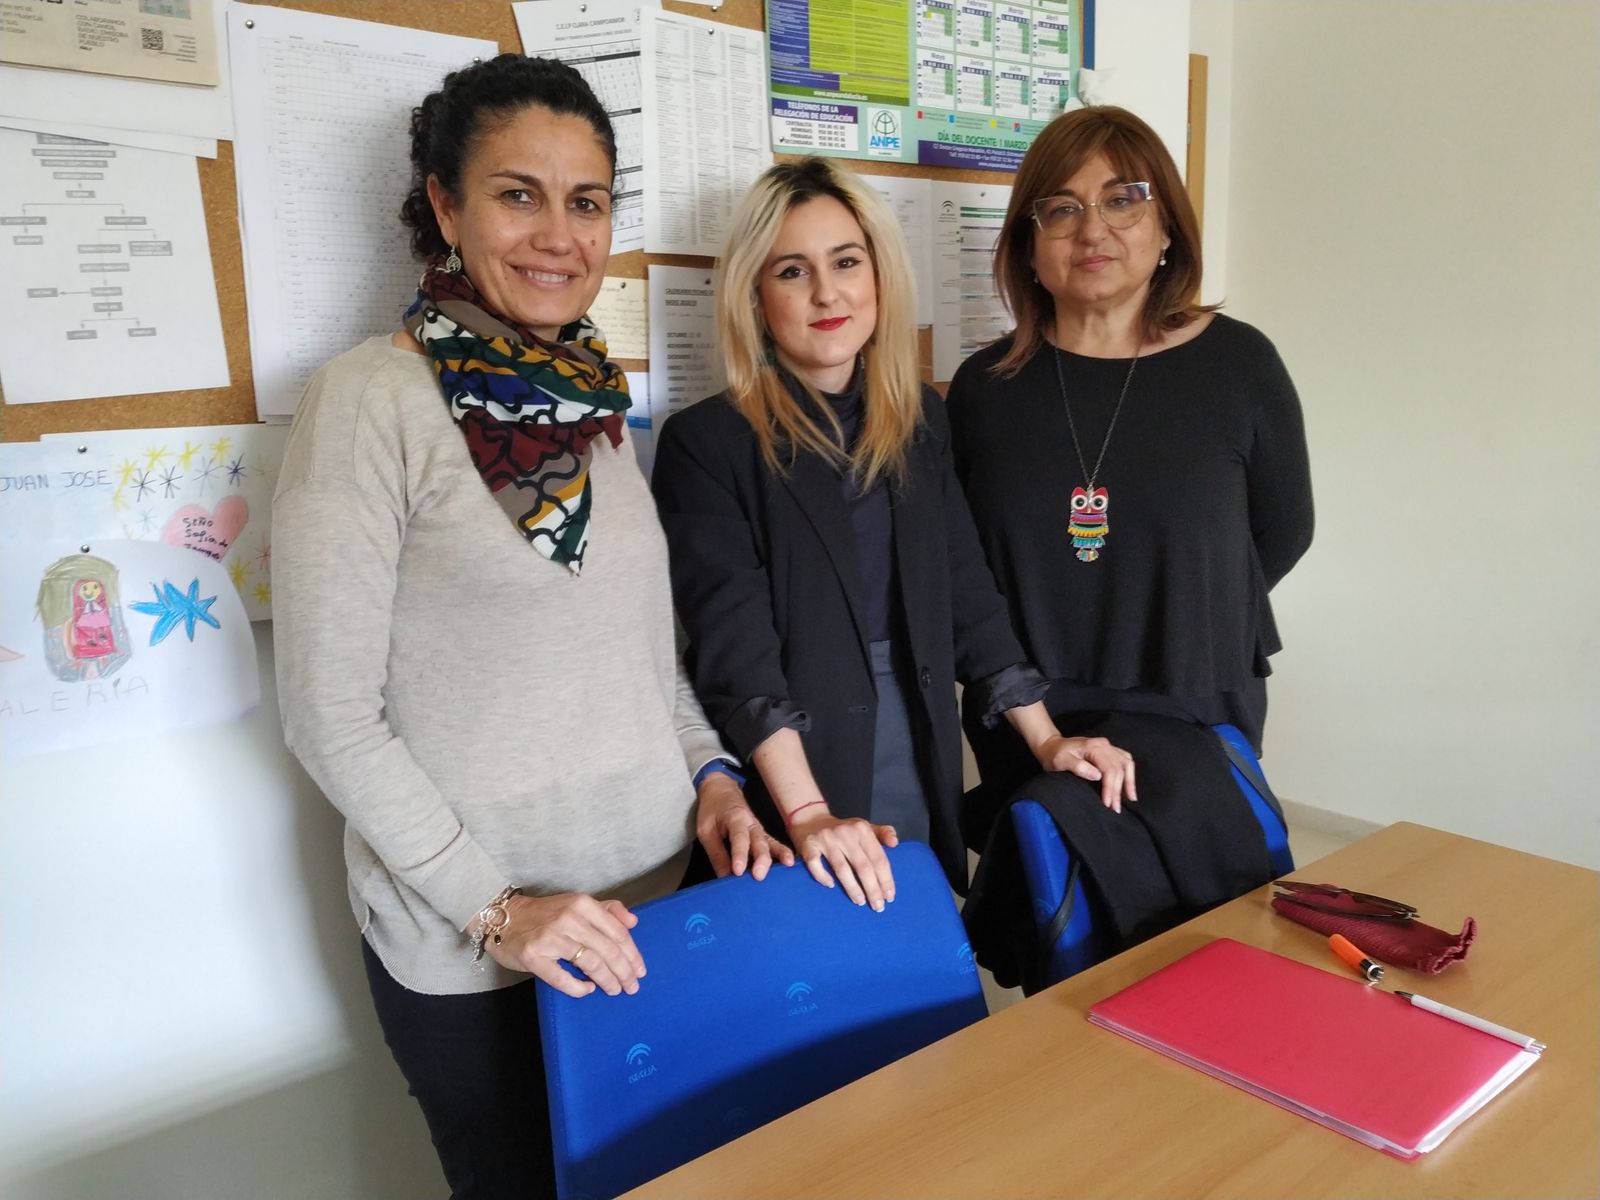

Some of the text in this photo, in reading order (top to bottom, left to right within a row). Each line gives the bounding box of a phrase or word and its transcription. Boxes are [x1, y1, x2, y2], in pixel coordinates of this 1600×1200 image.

[787, 101, 821, 112] TELÉFONOS
[821, 105, 831, 113] DE
[774, 108, 854, 122] DELEGACIÓN DE EDUCACIÓN
[870, 135, 900, 148] ANPE
[937, 129, 950, 142] DÍA
[951, 133, 964, 144] DEL
[965, 135, 997, 147] DOCENTE
[1003, 139, 1028, 150] MARZO
[0, 469, 113, 493] JUAN JOSE
